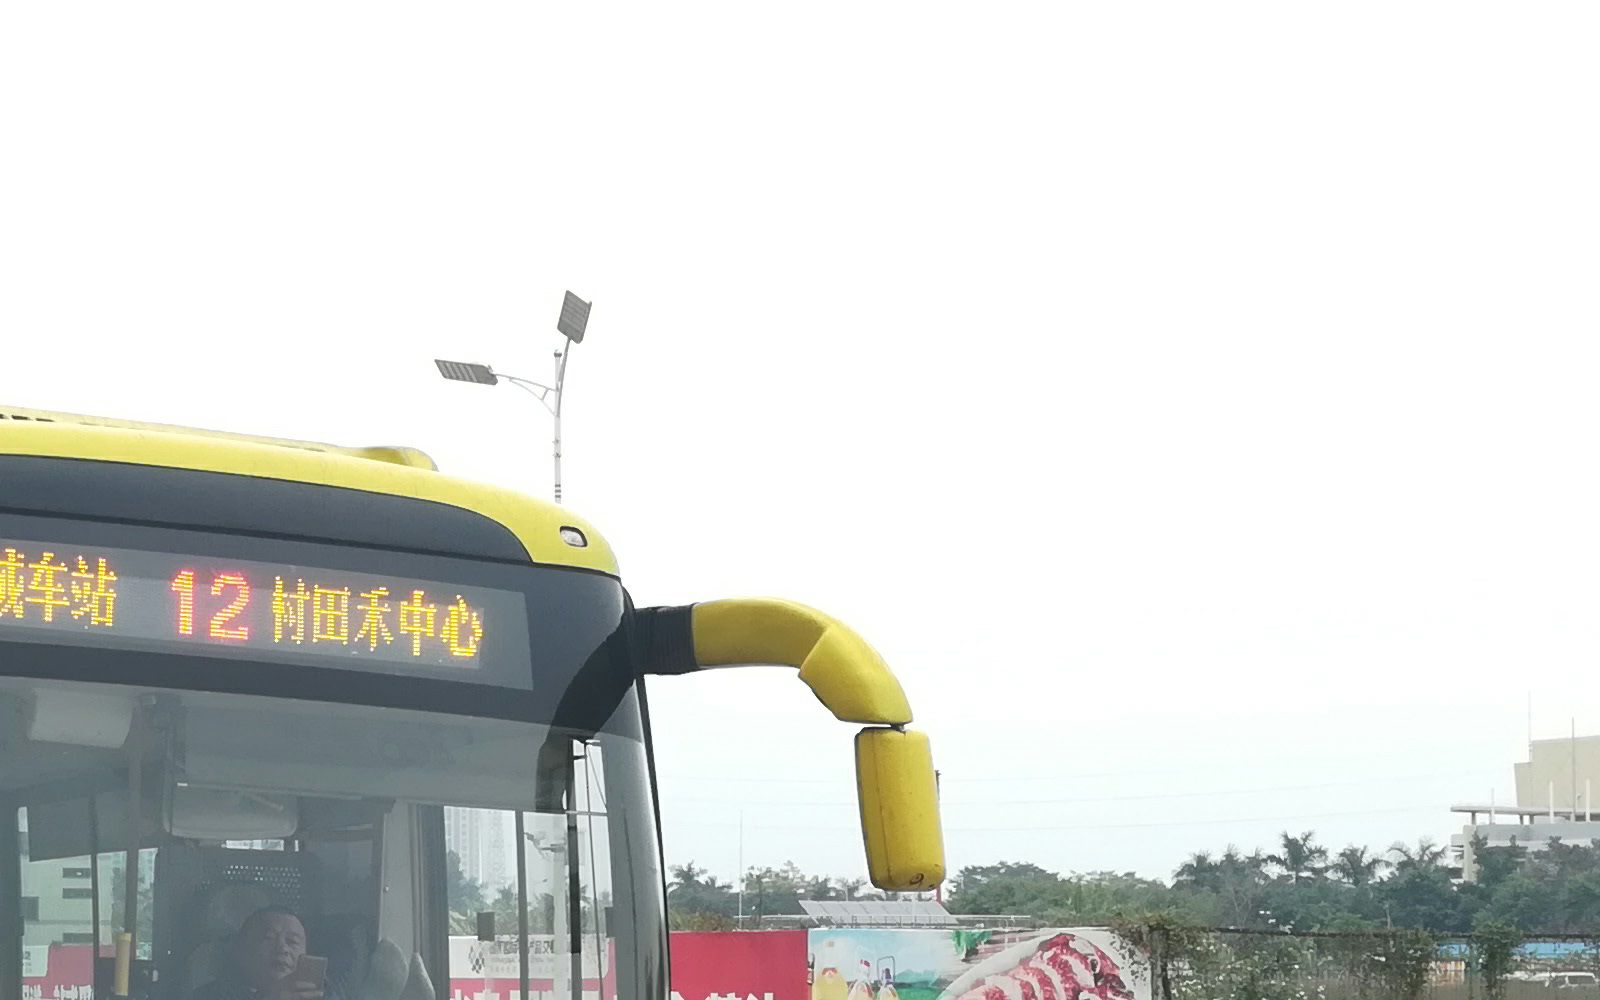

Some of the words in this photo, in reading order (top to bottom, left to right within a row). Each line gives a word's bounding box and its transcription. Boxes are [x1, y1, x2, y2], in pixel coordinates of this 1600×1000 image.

[171, 569, 251, 642] 12
[273, 576, 483, 656] 村田禾中心
